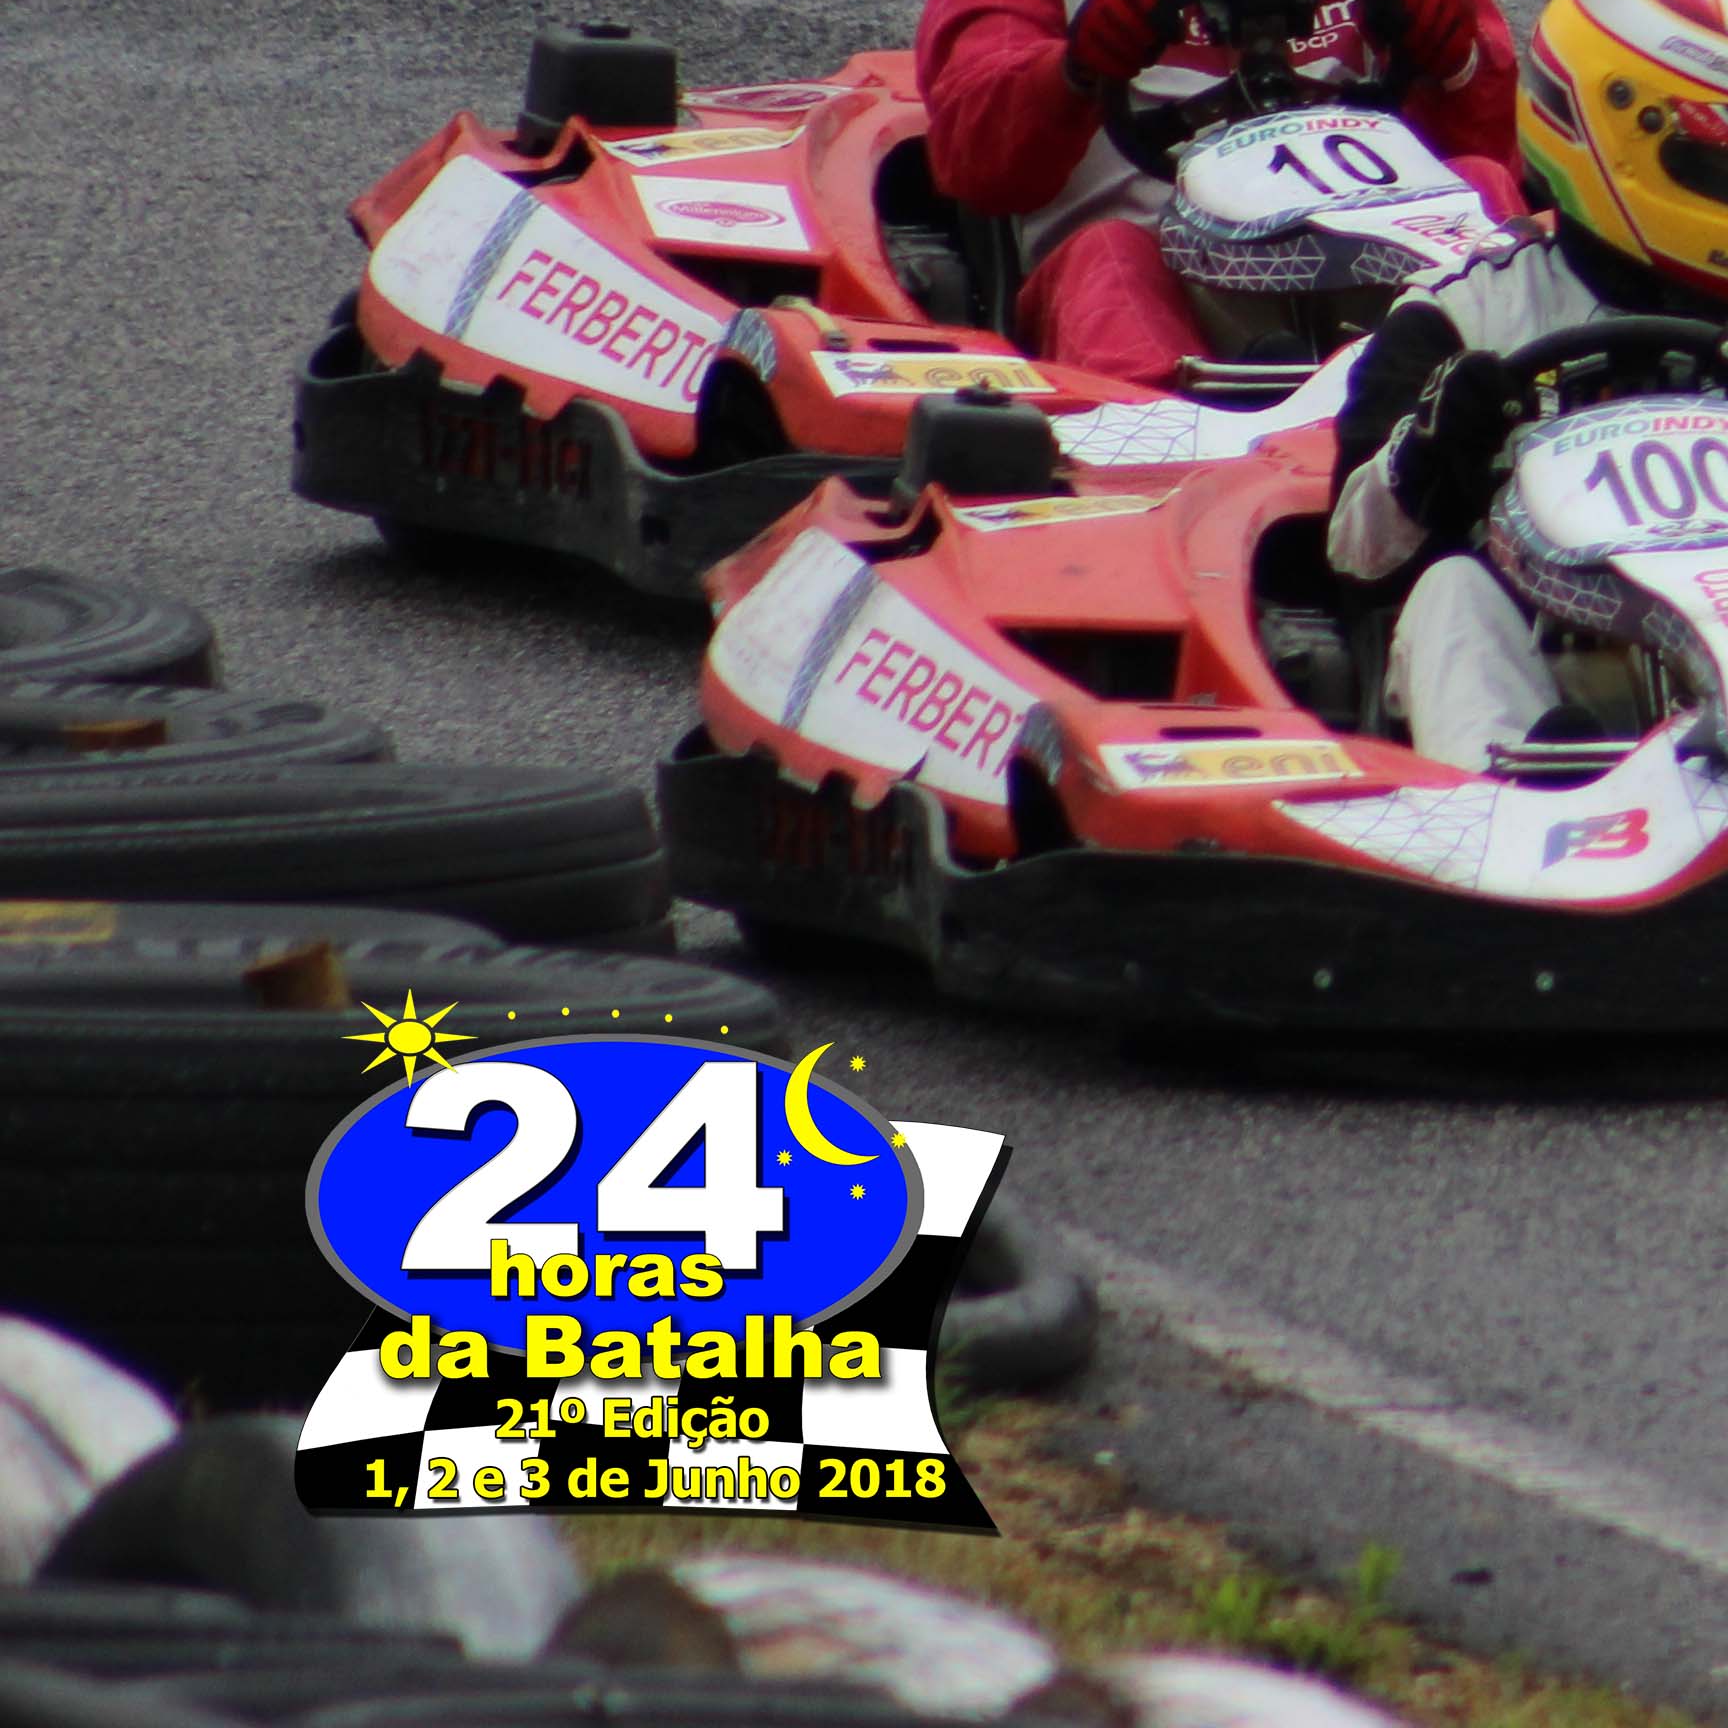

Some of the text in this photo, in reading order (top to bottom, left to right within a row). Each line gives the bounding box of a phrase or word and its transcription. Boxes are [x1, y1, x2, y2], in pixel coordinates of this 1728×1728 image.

[1286, 31, 1339, 54] bcp
[1215, 117, 1385, 157] EUROINDY
[1267, 133, 1399, 195] 10
[835, 627, 1027, 779] FERBERT
[1221, 745, 1345, 778] eni
